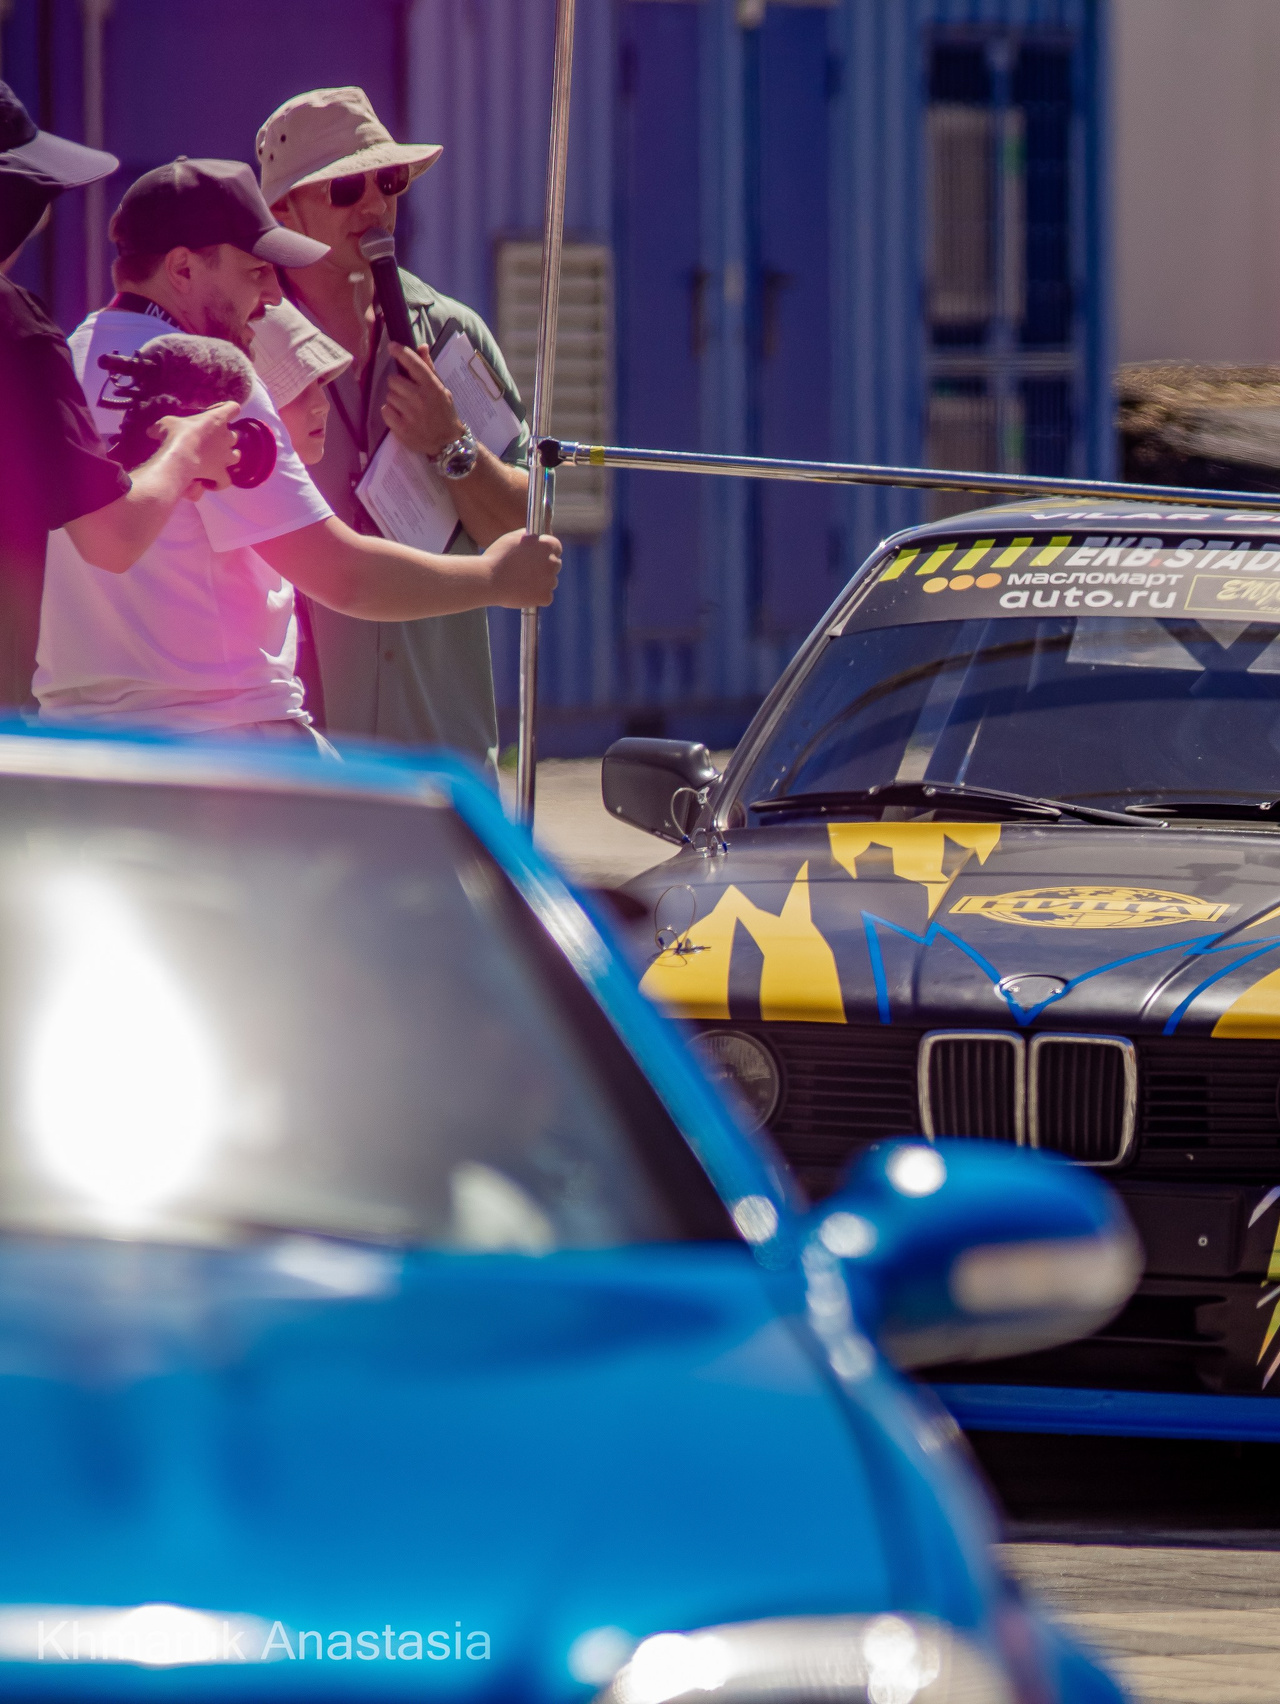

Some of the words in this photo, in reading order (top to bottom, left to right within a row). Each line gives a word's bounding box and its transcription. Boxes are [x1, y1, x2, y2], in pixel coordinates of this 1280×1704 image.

[1030, 512, 1212, 521] VILAR
[1006, 572, 1184, 588] масломарт
[999, 587, 1177, 609] auto.ru
